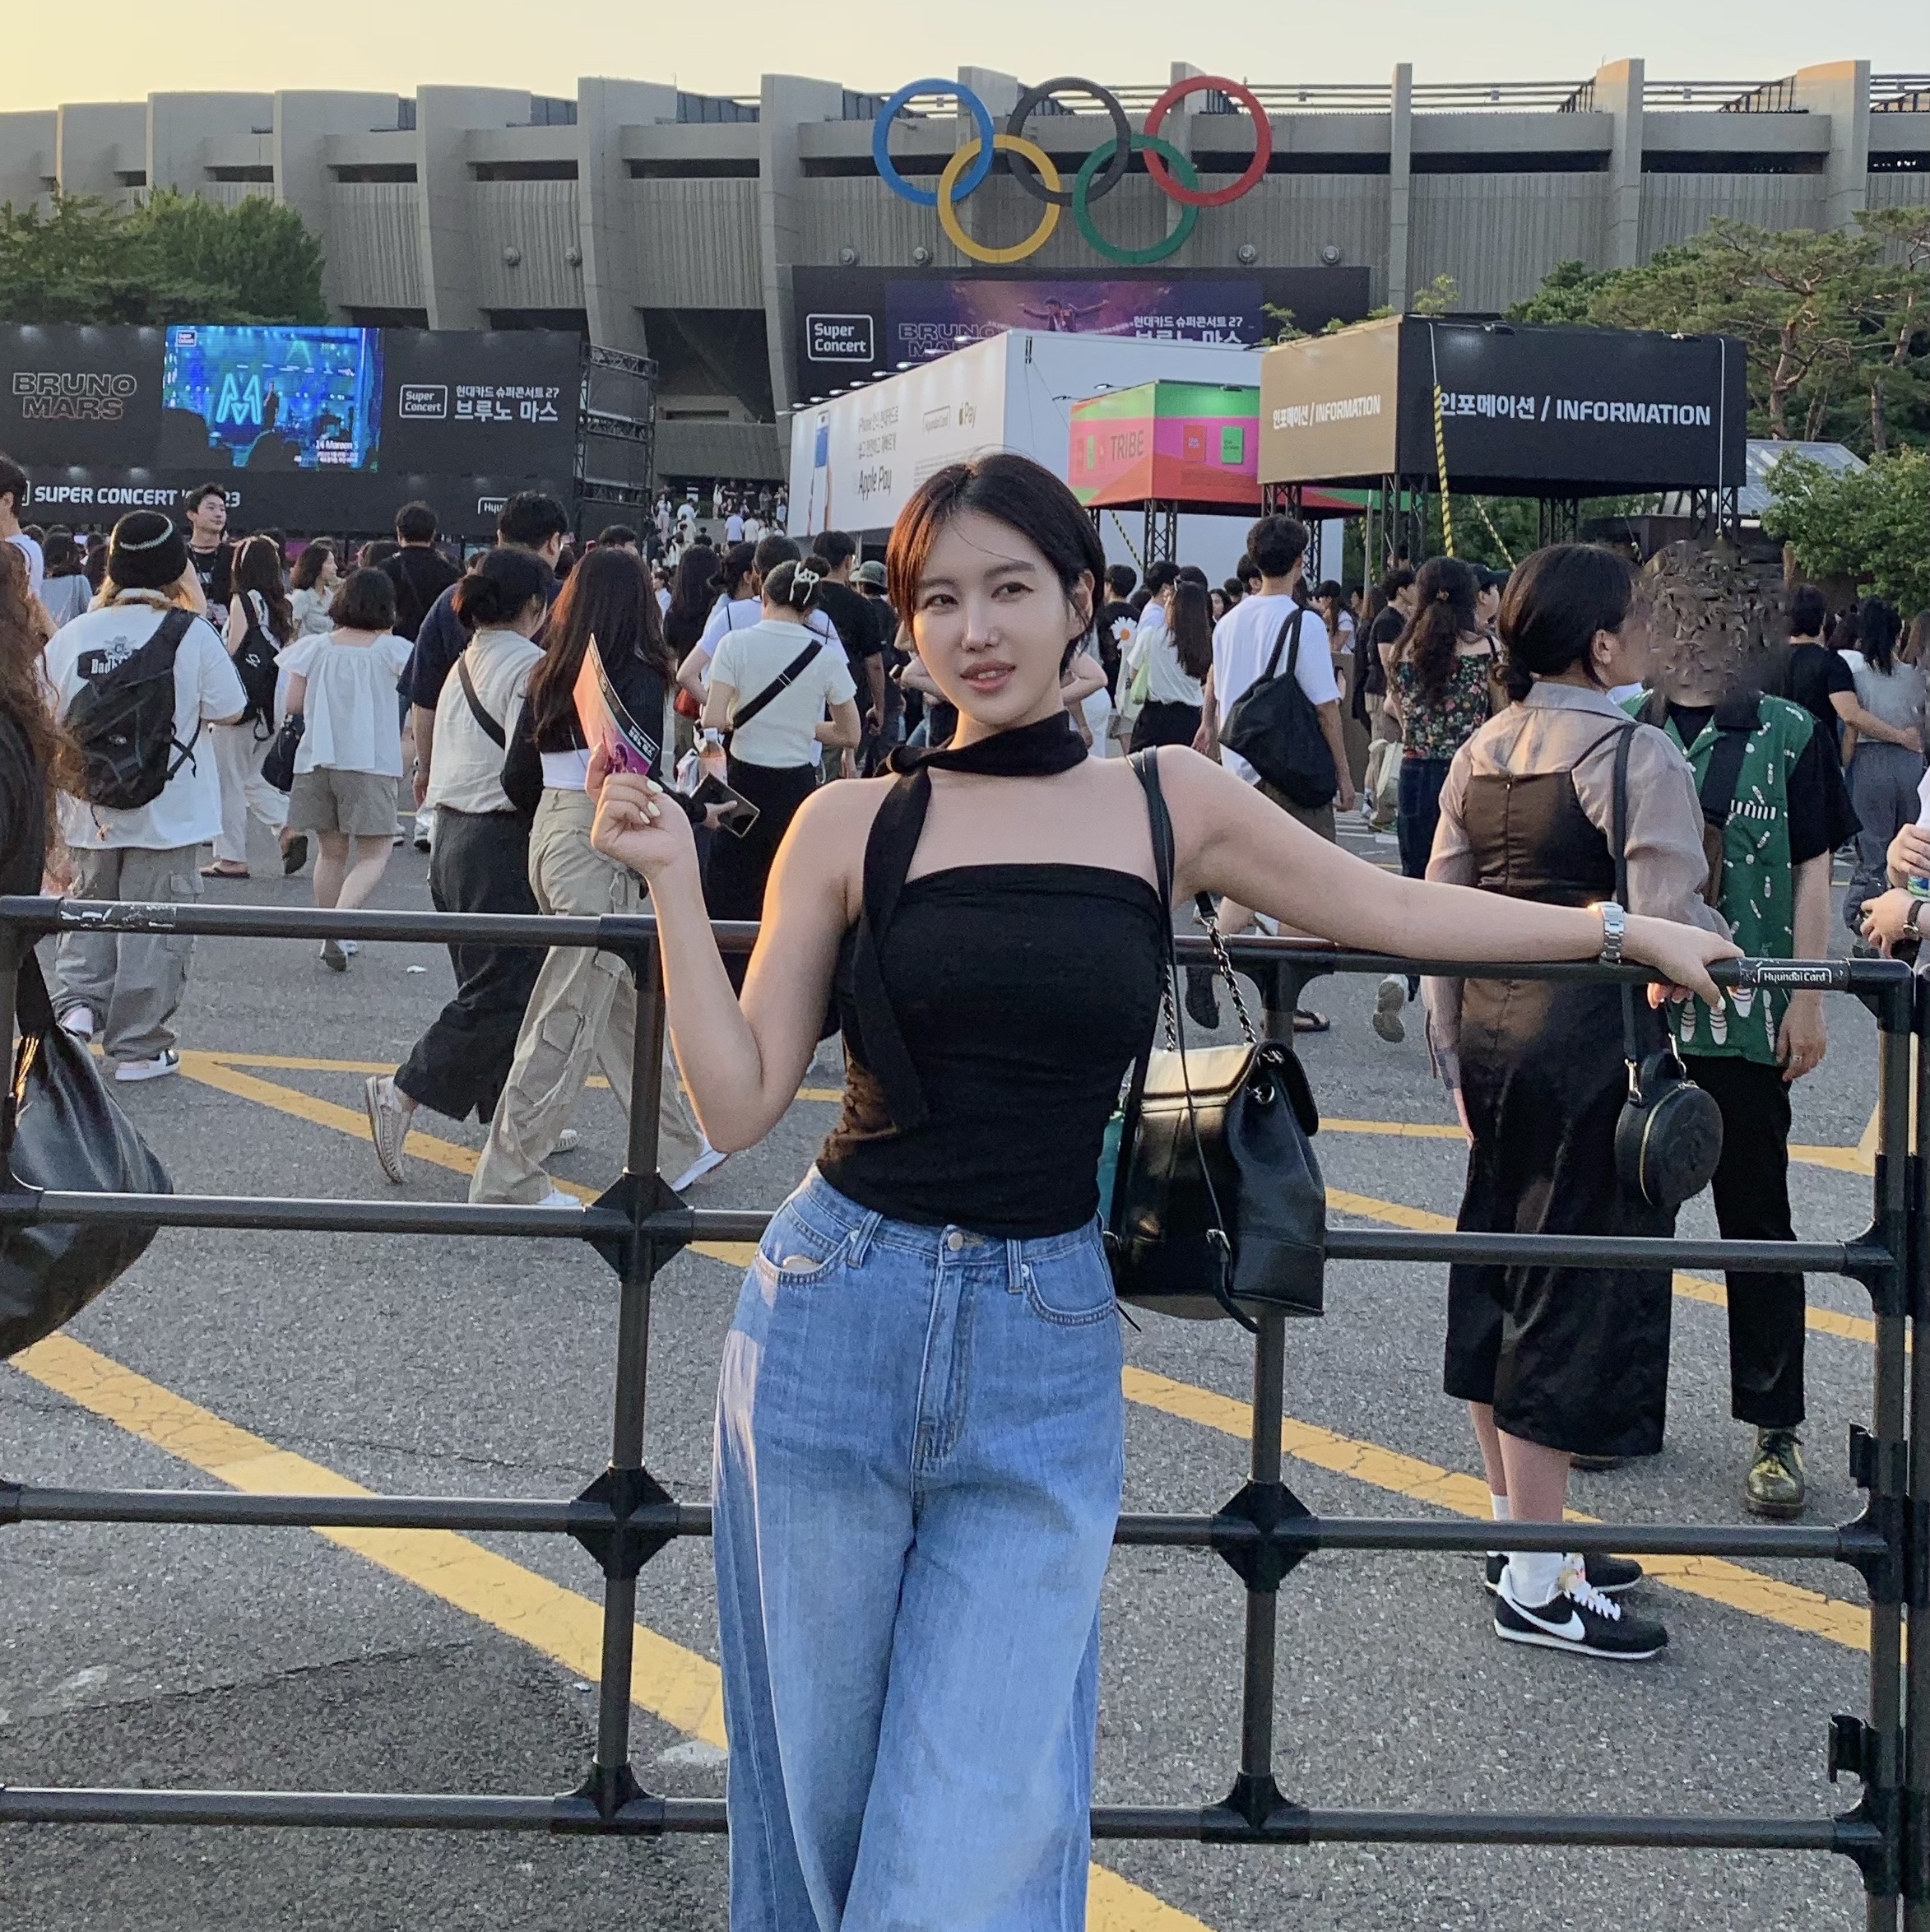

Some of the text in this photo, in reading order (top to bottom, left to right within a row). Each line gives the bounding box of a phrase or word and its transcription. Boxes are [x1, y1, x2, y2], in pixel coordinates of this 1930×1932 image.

[814, 323, 855, 339] Super
[1134, 316, 1243, 328] 현대카드 슈퍼콘서트 27
[814, 339, 866, 353] Concert
[12, 372, 137, 397] BRUNO
[456, 386, 559, 399] 현대카드 슈퍼콘서트 27
[405, 401, 442, 412] Concert
[406, 390, 435, 403] Super
[22, 396, 124, 420] MARS
[454, 401, 559, 423] 브루노 마스
[1273, 404, 1309, 430] 인포메이션
[1315, 395, 1381, 422] INFORMATION
[1440, 392, 1535, 420] 인포메이션
[1557, 399, 1711, 426] INFORMATION
[1111, 430, 1144, 462] TRIBE
[858, 466, 877, 501] Apple
[878, 465, 892, 496] Pay
[35, 486, 93, 504] SUPER
[97, 487, 178, 506] CONCERT
